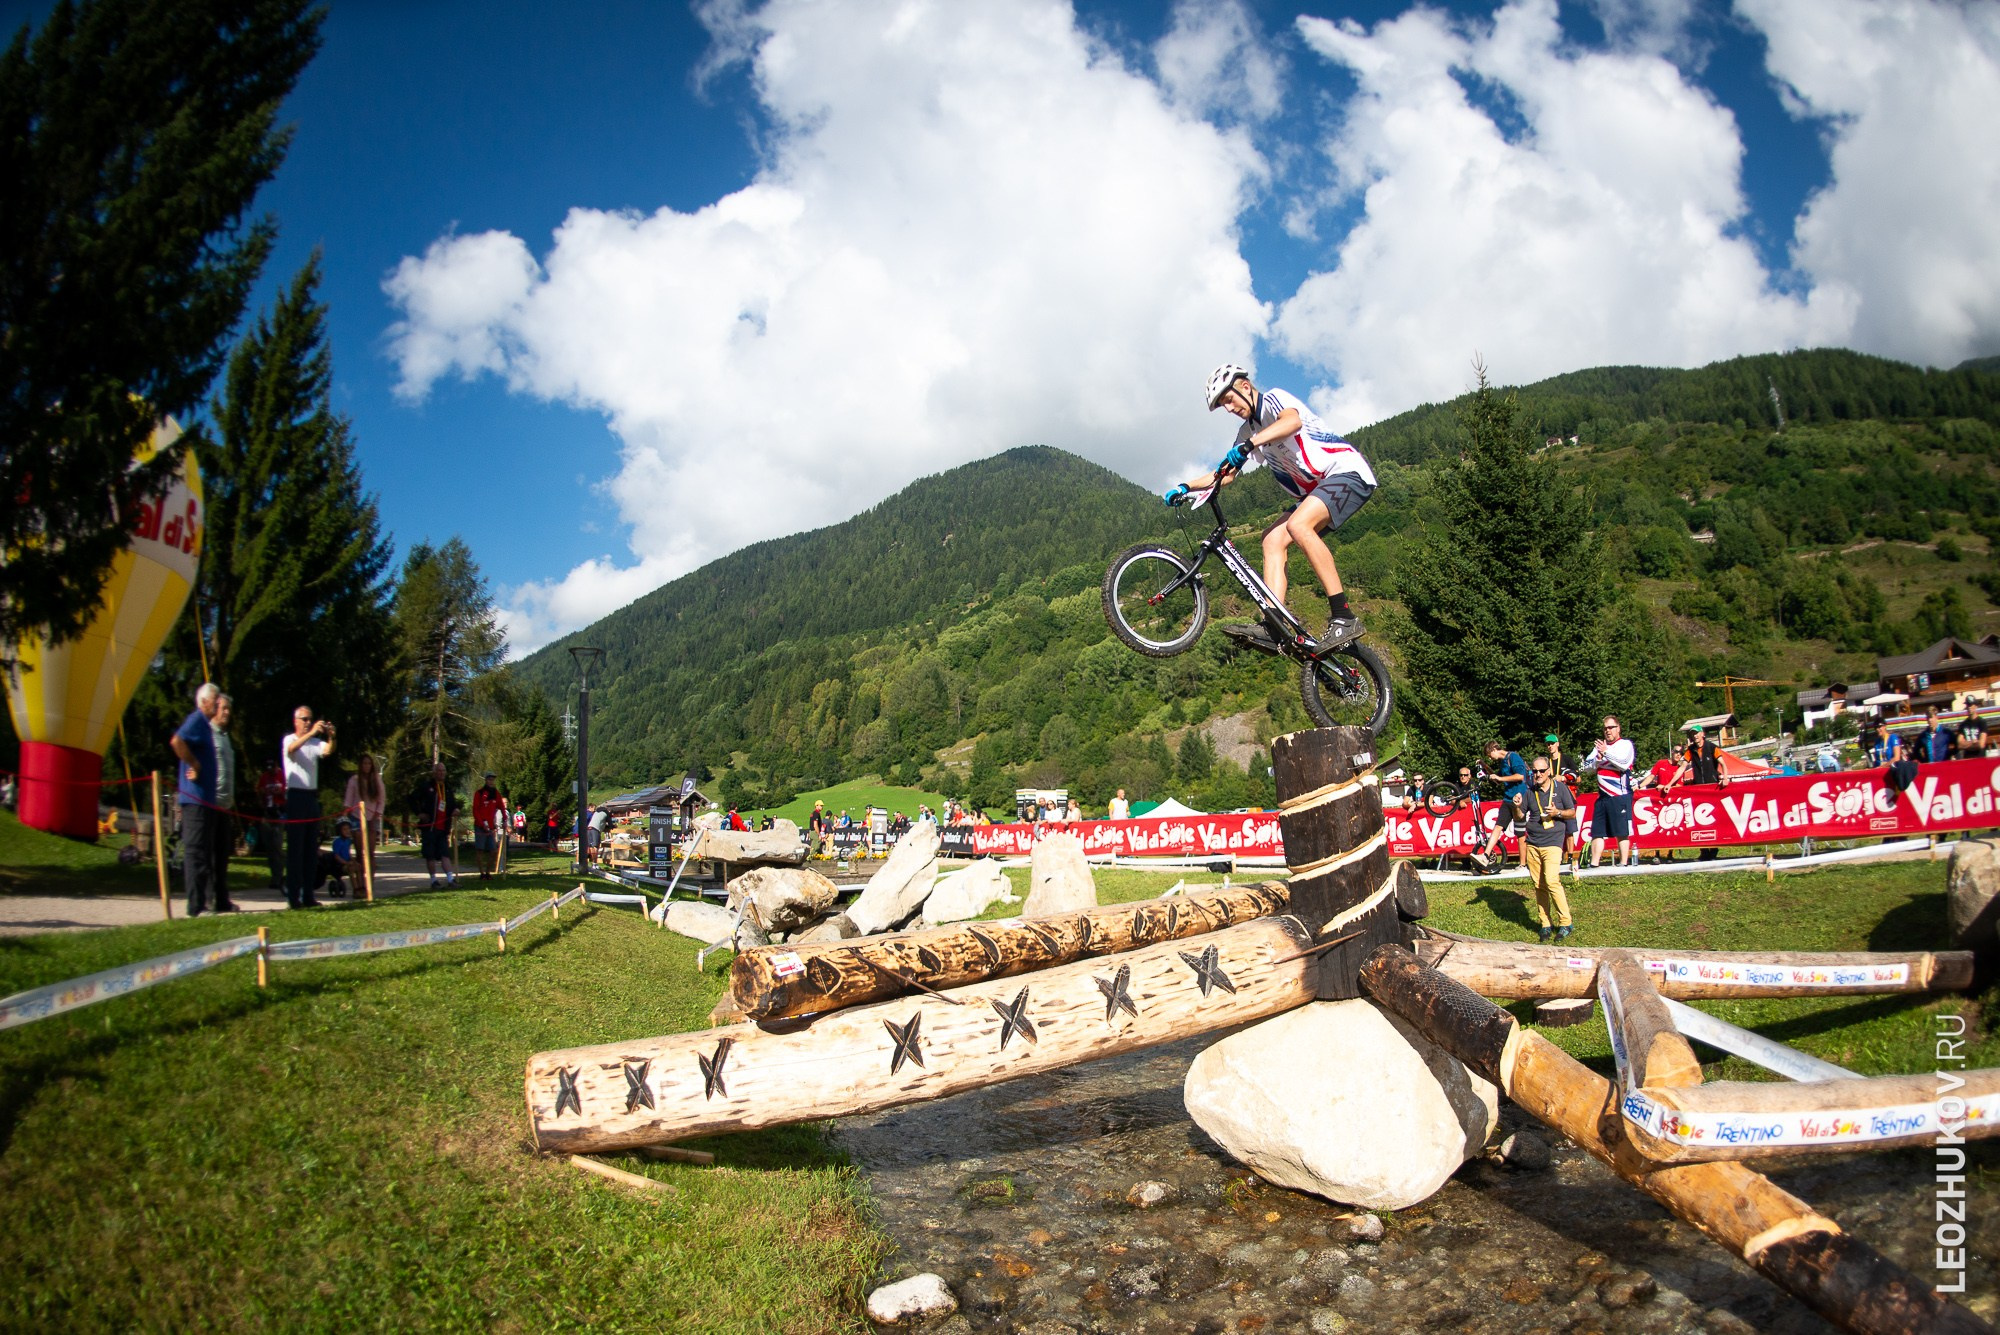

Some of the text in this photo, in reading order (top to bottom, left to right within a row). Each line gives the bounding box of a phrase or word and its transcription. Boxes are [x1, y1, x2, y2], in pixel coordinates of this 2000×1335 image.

[133, 495, 164, 541] al
[686, 781, 694, 792] 2
[1721, 781, 1897, 838] Val di Sole
[1905, 777, 1964, 826] Val
[1966, 786, 1993, 815] di
[876, 822, 883, 833] 2
[1633, 797, 1716, 836] Sole
[658, 828, 664, 842] 1
[974, 831, 987, 851] Val
[993, 828, 1014, 848] Sole
[1016, 830, 1031, 851] Val
[1085, 835, 1094, 849] di
[1094, 825, 1124, 849] Sole
[1126, 822, 1195, 852] Val di Sole
[1197, 823, 1227, 851] Val
[1228, 831, 1242, 848] di
[1418, 817, 1461, 851] Val
[1698, 965, 1711, 979] Val
[1719, 967, 1739, 980] Sole
[1746, 969, 1784, 984] TRENTINO
[1792, 971, 1804, 983] Val
[1810, 971, 1828, 983] Sole
[1833, 971, 1866, 984] TRENTINO
[1873, 970, 1885, 981] Val
[1716, 1122, 1783, 1143] TRENTINO
[1800, 1119, 1819, 1137] Val
[1820, 1127, 1831, 1137] di
[1830, 1118, 1862, 1137] Sole
[1870, 1114, 1926, 1136] TRENTINO
